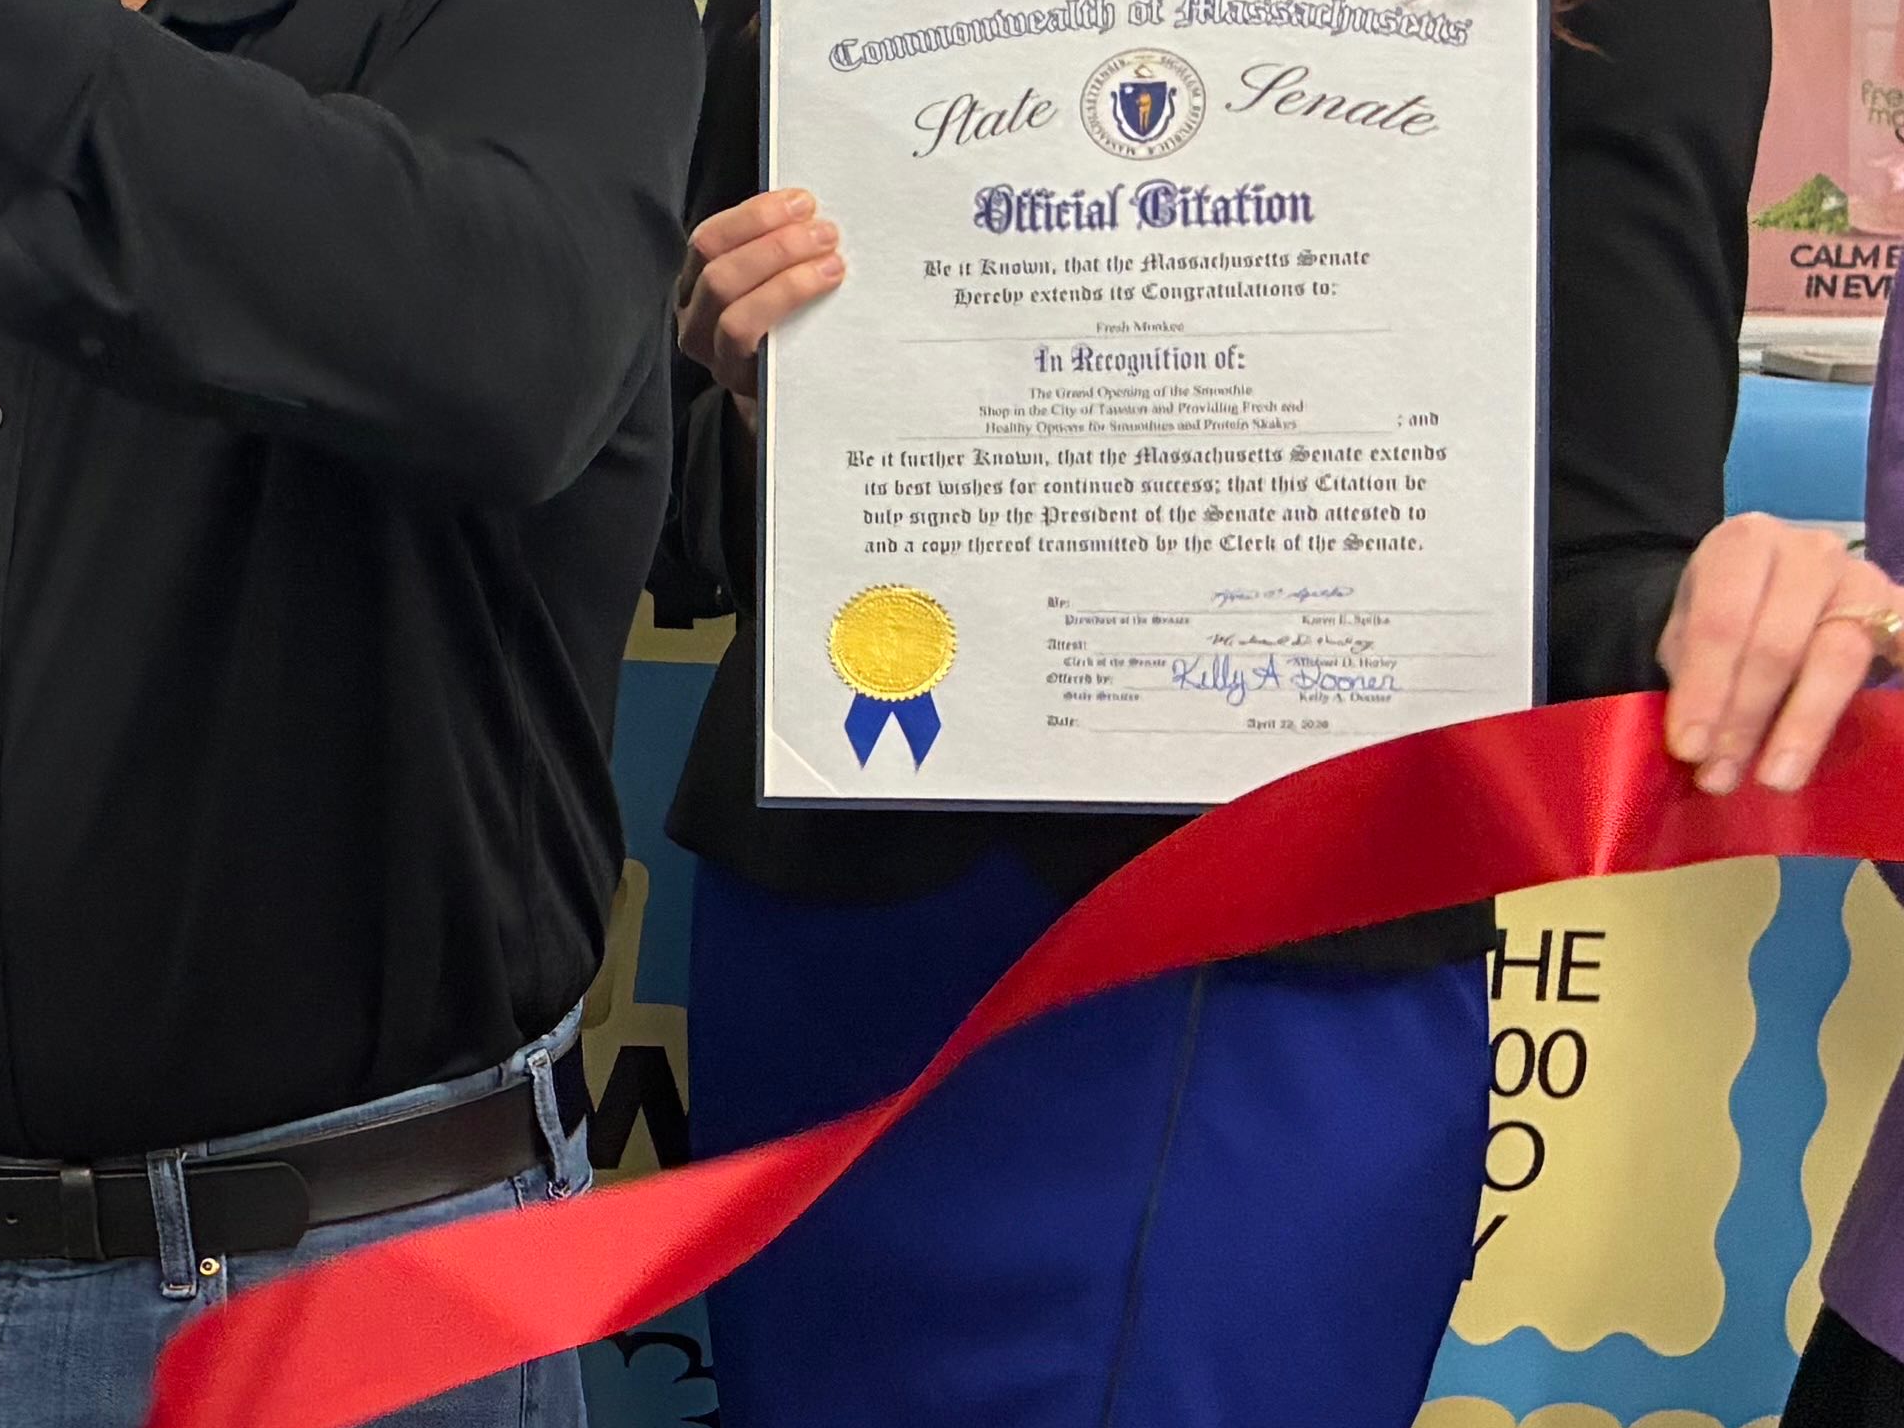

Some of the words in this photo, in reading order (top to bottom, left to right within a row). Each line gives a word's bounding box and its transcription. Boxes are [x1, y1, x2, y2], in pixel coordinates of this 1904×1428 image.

[912, 87, 1061, 159] State
[1225, 63, 1441, 138] Senate
[973, 181, 1123, 235] Official
[1130, 178, 1315, 228] Citation
[923, 259, 952, 279] Be
[959, 262, 972, 277] it
[980, 258, 1057, 277] Known,
[1064, 256, 1100, 275] that
[1106, 255, 1134, 275] the
[1140, 252, 1290, 273] Massachusetts
[1296, 249, 1371, 267] Senate
[1790, 244, 1880, 268] CALM
[1806, 275, 1837, 298] IN
[1096, 320, 1130, 334] Fresh
[1133, 320, 1185, 333] Monkee
[1034, 345, 1063, 373] In
[1071, 343, 1207, 378] Recognition
[1214, 344, 1246, 370] of:
[1172, 654, 1249, 706] Kelly
[1252, 654, 1280, 690] A
[1491, 929, 1605, 1002] HE
[1491, 1027, 1588, 1099] 00
